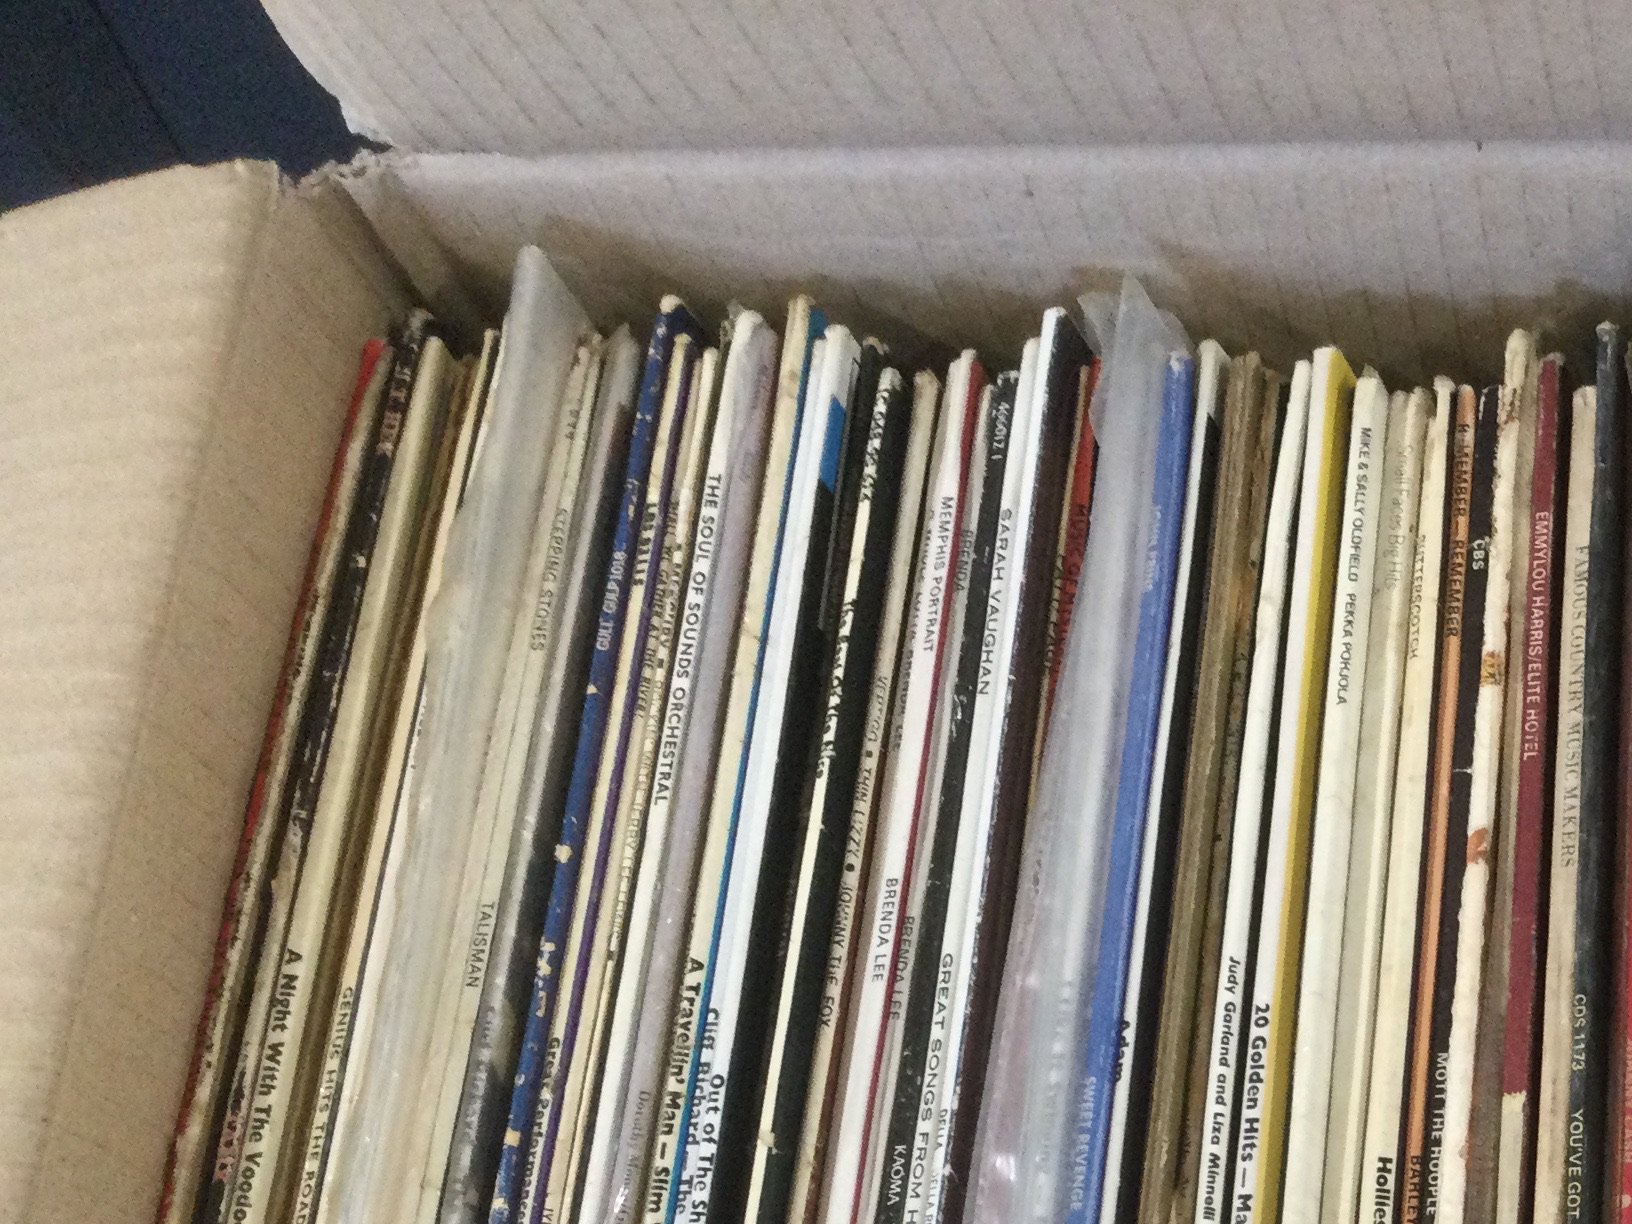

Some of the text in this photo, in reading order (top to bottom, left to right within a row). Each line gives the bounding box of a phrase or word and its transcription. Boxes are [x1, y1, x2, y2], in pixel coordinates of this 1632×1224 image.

[932, 496, 953, 570] MEMPHIS
[951, 528, 973, 592] BRENDA
[1334, 428, 1372, 706] MIKE & SALLY OLDFIELD PEKKA POHJOLA
[1470, 538, 1486, 570] CBS
[921, 576, 942, 652] PORTRAIT
[976, 508, 1013, 696] SARAH VAUGHAN
[1522, 510, 1549, 760] EMMYLOU HARRIS/ELITE HOTEL
[653, 474, 721, 806] THE SOUL OF SOUNDS ORCHESTRAL
[1558, 544, 1590, 868] FAMOUS COUNTRY MUSIC MAKERS
[283, 948, 304, 964] A
[465, 902, 495, 988] TALISMAN
[870, 878, 899, 982] BRENDA LEE
[686, 956, 705, 974] A
[887, 914, 915, 1020] BRENDA LEE
[931, 952, 955, 1030] GREAT
[1224, 956, 1240, 994] Judy
[266, 974, 300, 1032] Night
[667, 982, 701, 1084] Travellin'
[1218, 1002, 1236, 1066] Garland
[1252, 1002, 1270, 1028] 20
[1571, 994, 1586, 1072] CDS 1173
[257, 1040, 285, 1096] With
[704, 1074, 726, 1114] Out
[919, 1038, 943, 1122] SONGS
[1214, 1074, 1229, 1106] and
[1245, 1034, 1268, 1110] Golden
[248, 1104, 273, 1142] The
[659, 1090, 683, 1136] Man
[700, 1122, 720, 1144] of
[1068, 1076, 1097, 1212] SWEET REVENGE
[1211, 1112, 1225, 1146] Liza
[1239, 1118, 1259, 1162] Hits
[1424, 1052, 1449, 1216] MOTT THE HOOPLE
[1566, 1108, 1584, 1176] YOU'VE
[646, 1166, 671, 1212] Slim
[693, 1152, 714, 1192] The
[909, 1130, 930, 1198] FROM
[1202, 1152, 1221, 1220] Minnelli
[1565, 1182, 1581, 1220] GOT
